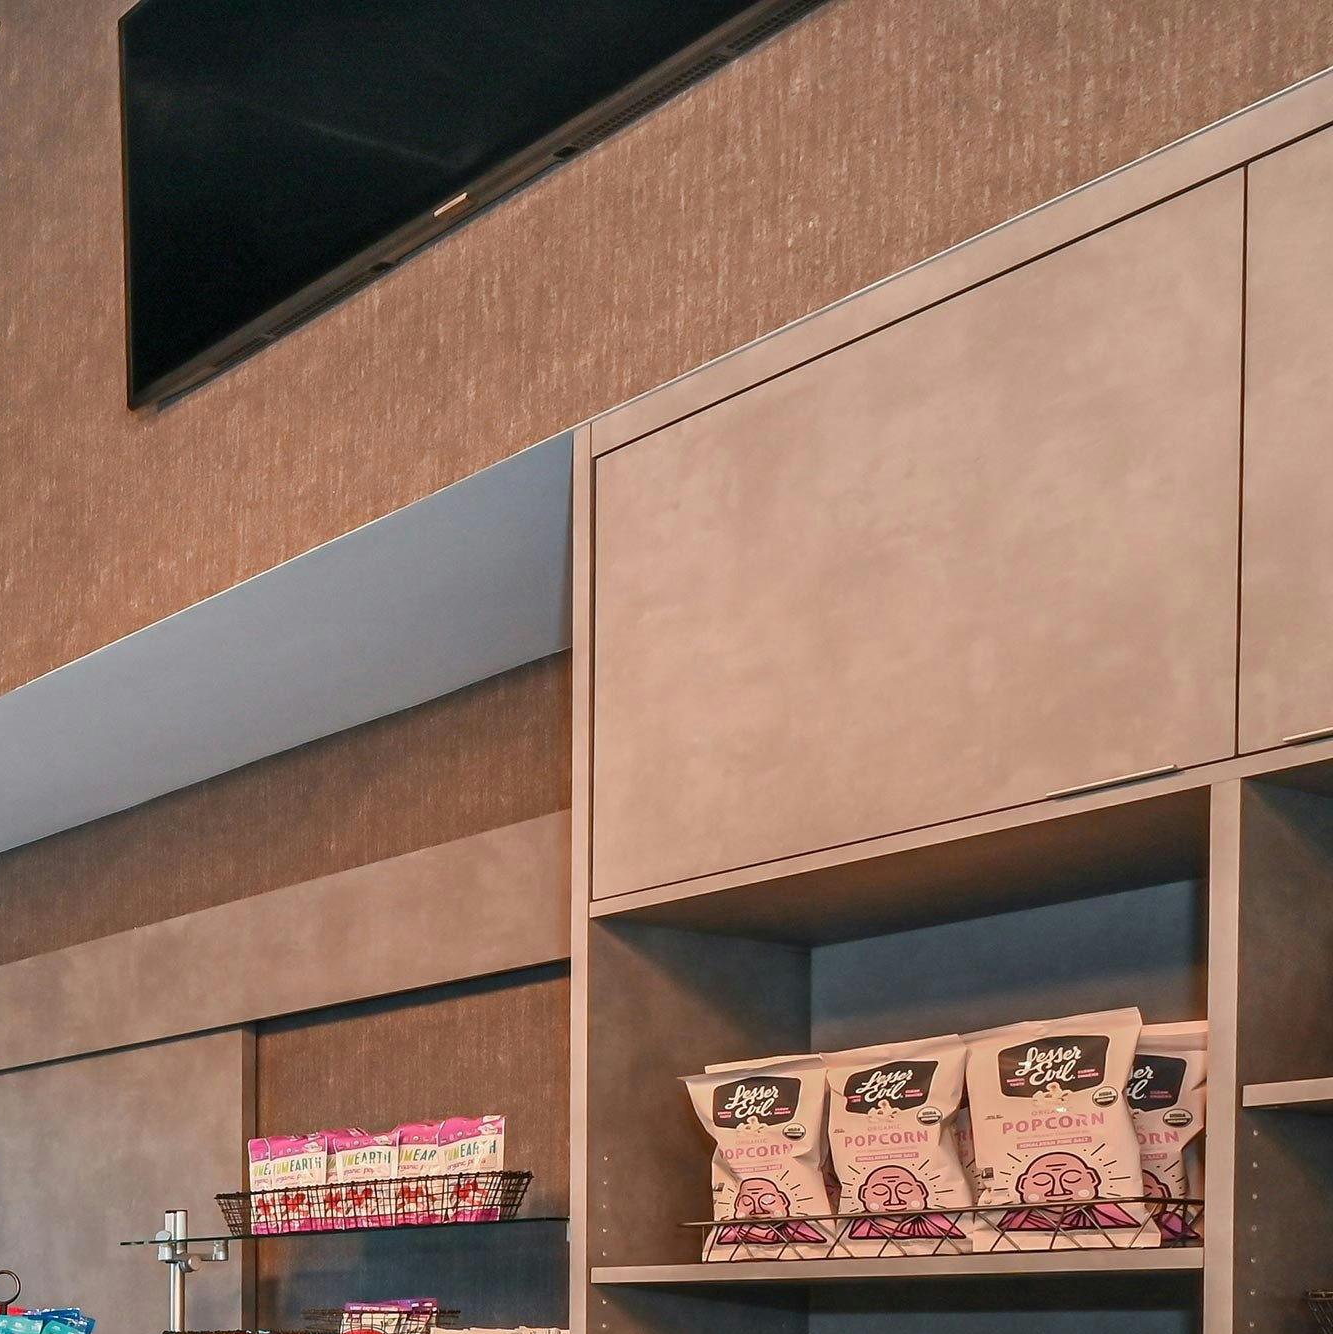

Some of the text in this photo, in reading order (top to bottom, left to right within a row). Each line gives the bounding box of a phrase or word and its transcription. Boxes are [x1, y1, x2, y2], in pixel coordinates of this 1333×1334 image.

[1014, 1045, 1082, 1077] Lesser
[854, 1069, 914, 1095] Lesser
[724, 1084, 779, 1110] Lesser
[1002, 1112, 1105, 1135] POPCORN
[844, 1130, 929, 1148] POPCORN
